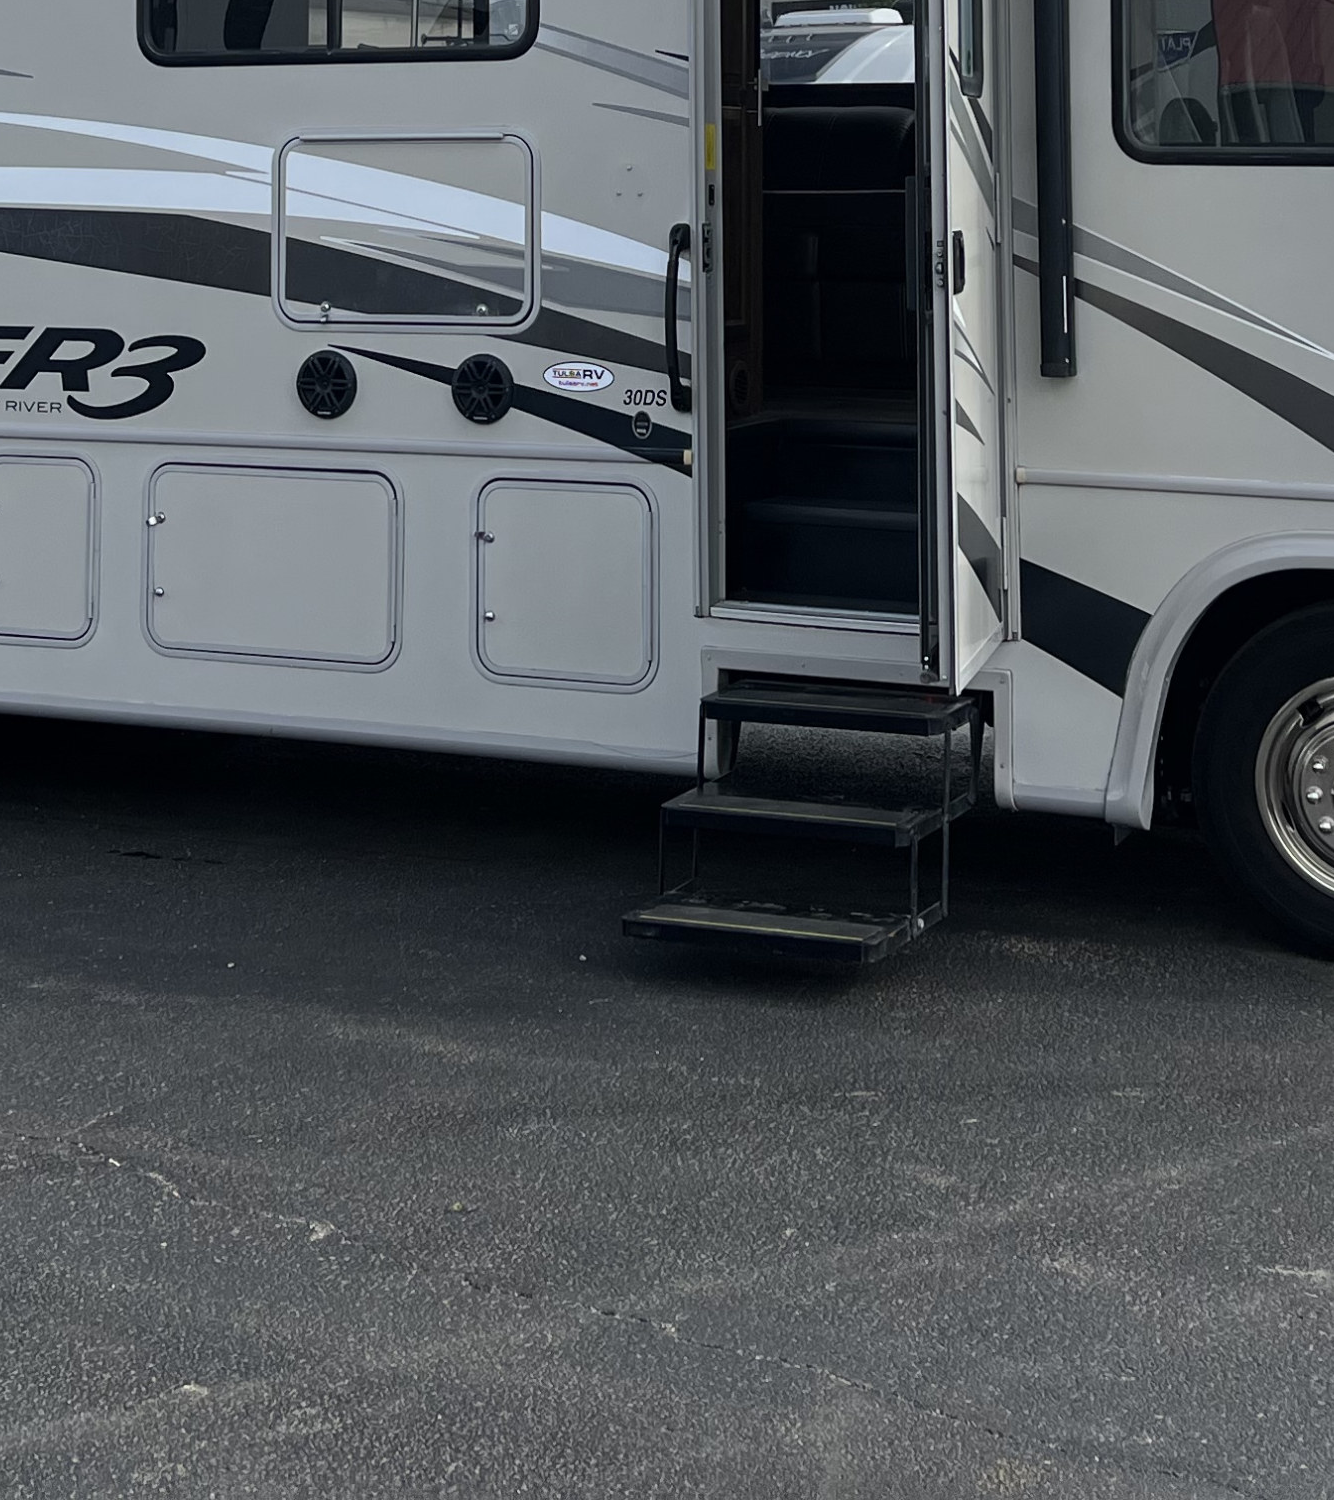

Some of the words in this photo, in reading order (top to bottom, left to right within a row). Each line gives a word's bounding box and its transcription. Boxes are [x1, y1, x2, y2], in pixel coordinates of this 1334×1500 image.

[582, 369, 605, 380] RV
[623, 389, 667, 406] 30DS
[5, 400, 62, 414] RIVER
